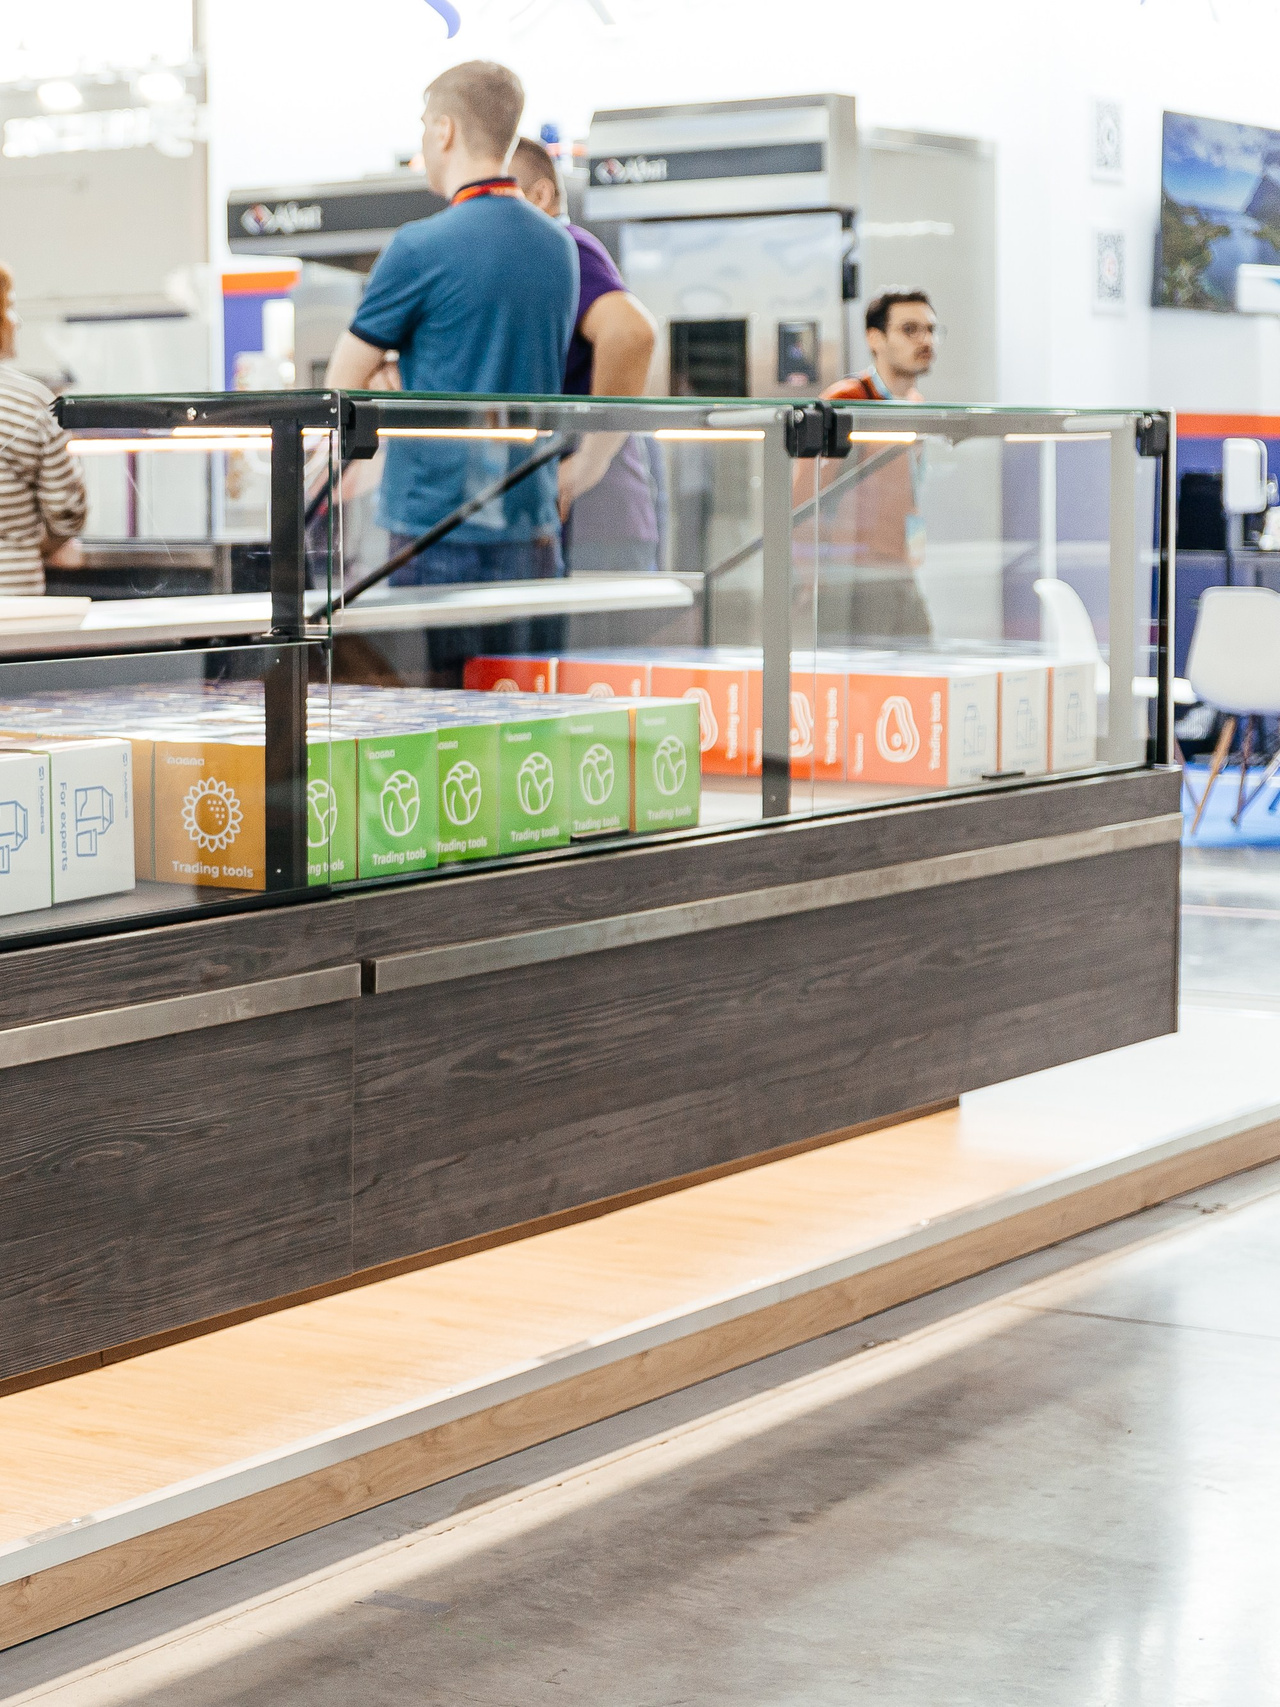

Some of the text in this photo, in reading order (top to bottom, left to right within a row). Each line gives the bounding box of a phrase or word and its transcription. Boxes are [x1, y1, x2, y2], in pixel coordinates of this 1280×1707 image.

[60, 782, 68, 871] For experts
[373, 848, 427, 865] Trading tools
[172, 860, 254, 878] Trading tools
